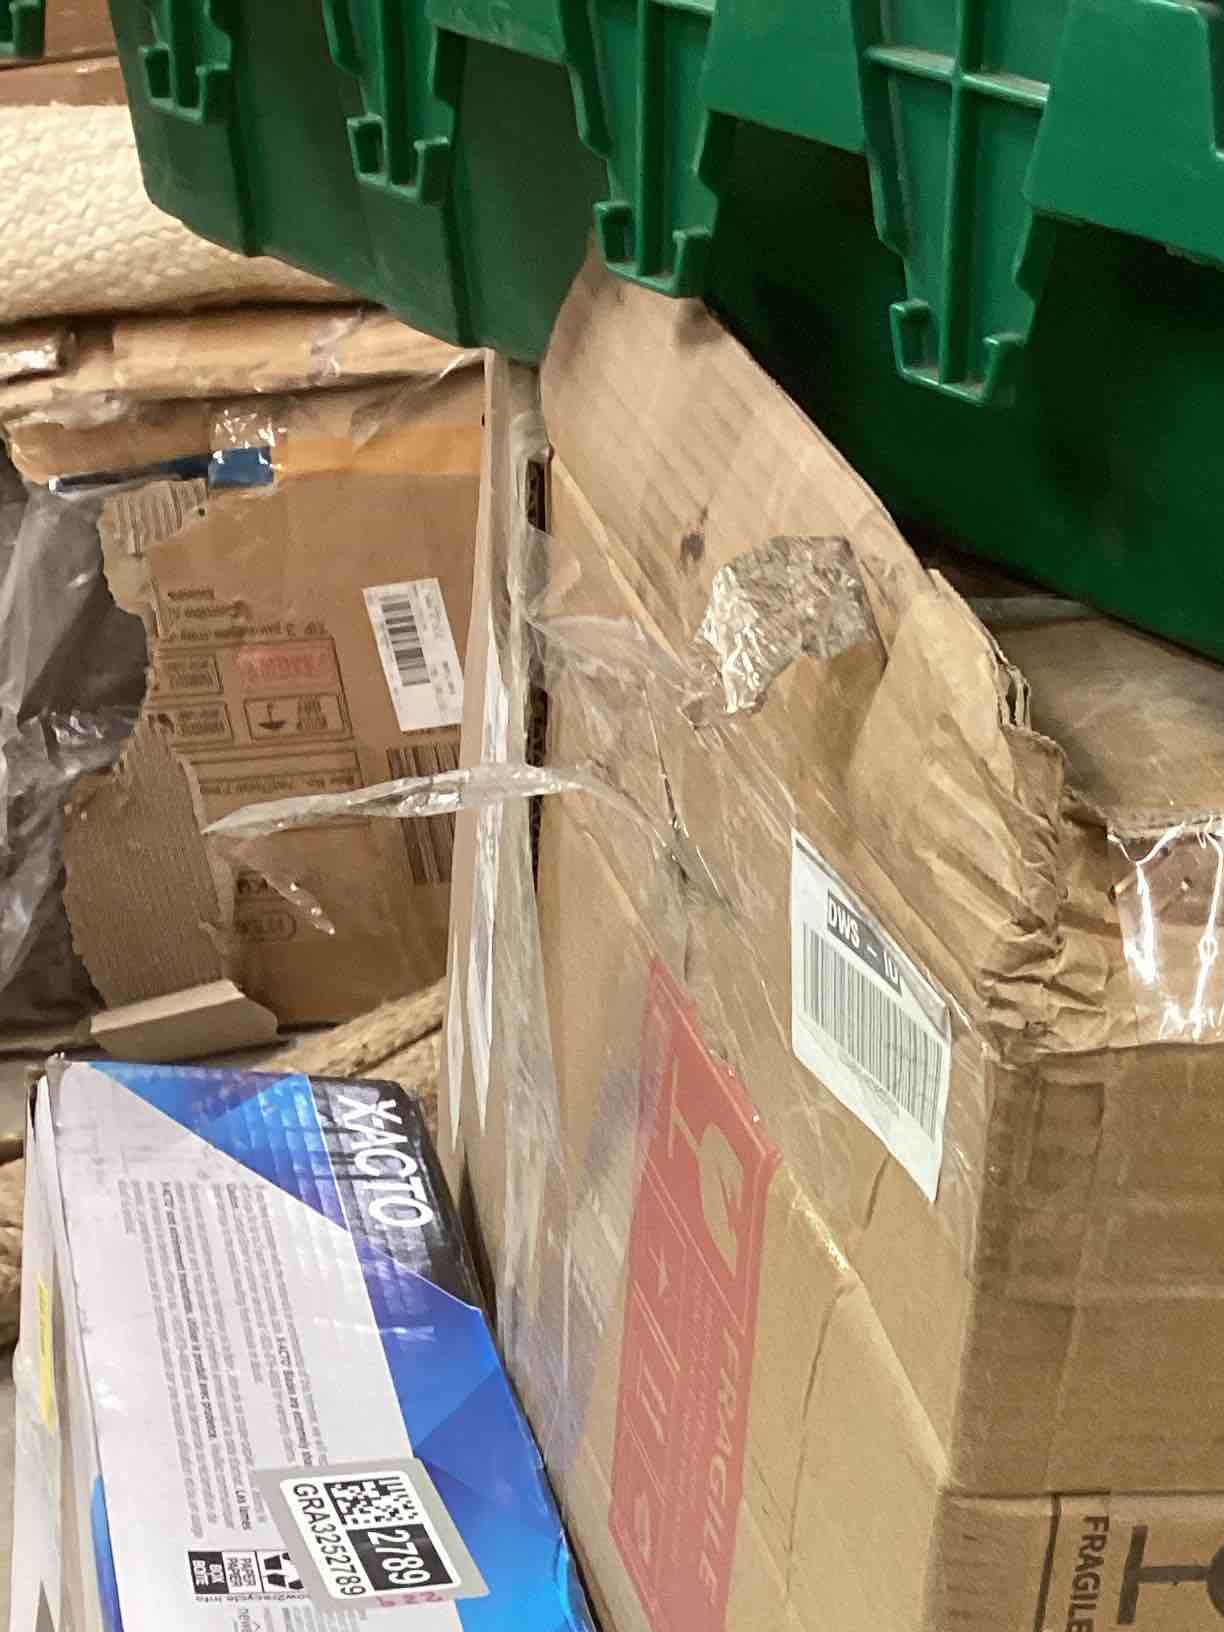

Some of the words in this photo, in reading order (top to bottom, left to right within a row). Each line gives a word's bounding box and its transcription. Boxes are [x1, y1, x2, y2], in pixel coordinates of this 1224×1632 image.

[828, 898, 861, 946] DWS
[336, 1094, 434, 1228] X-ACTO
[292, 1482, 367, 1597] GRA3252789
[367, 1528, 432, 1586] 2789
